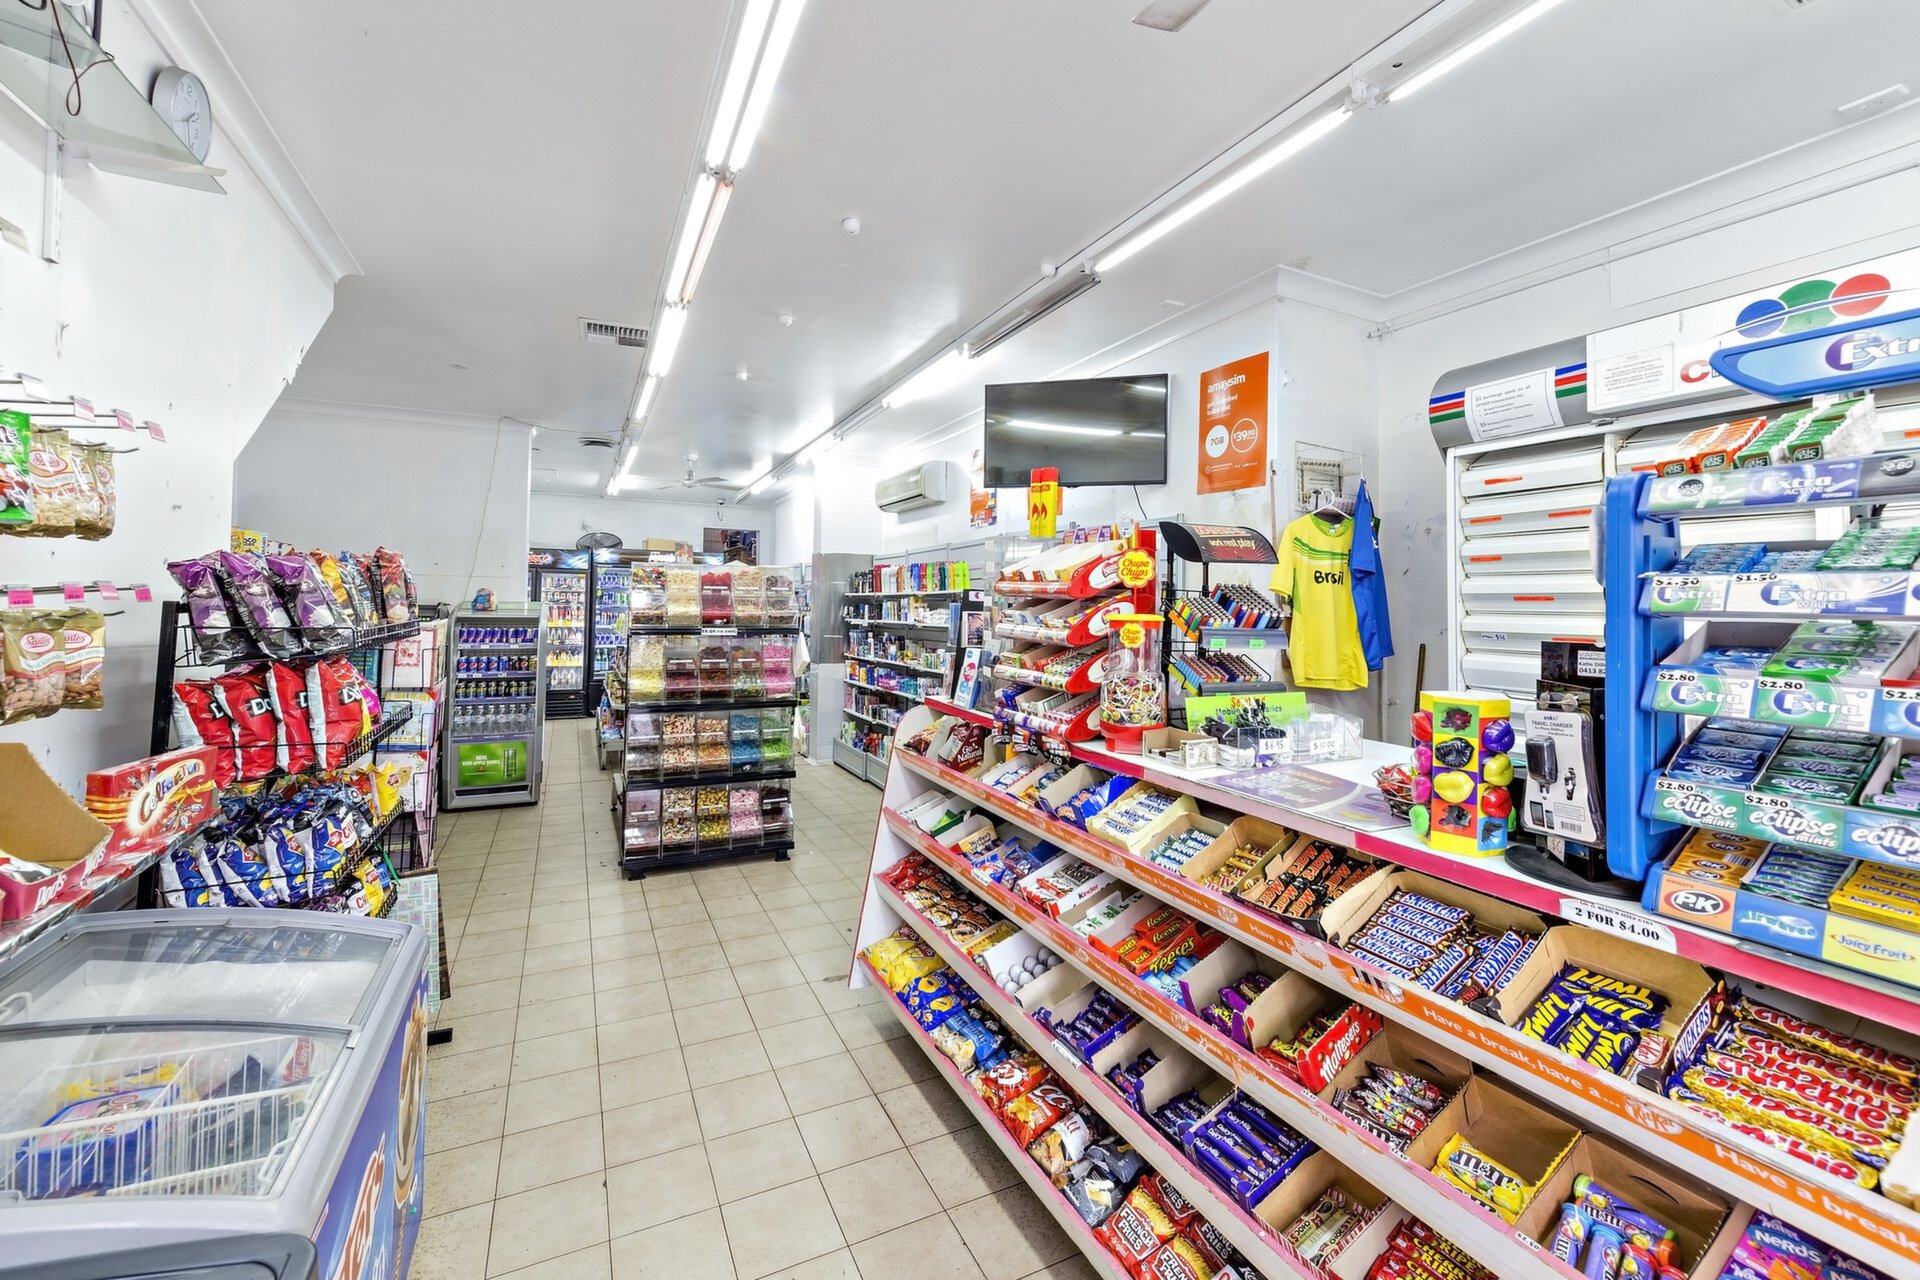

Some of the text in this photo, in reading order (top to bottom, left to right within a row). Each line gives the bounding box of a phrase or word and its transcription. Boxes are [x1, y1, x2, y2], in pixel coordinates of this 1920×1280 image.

[1208, 374, 1246, 393] amaysim
[1210, 436, 1224, 446] 7GB
[1761, 475, 1834, 492] Extra
[1121, 566, 1149, 578] Chups
[1122, 558, 1150, 571] Chupa
[1775, 586, 1848, 602] Extra
[1797, 601, 1836, 610] WHITE
[1658, 672, 1696, 682] $2.80
[1758, 680, 1804, 690] $2.80
[1678, 684, 1744, 704] Extra
[1783, 690, 1862, 716] Extra
[957, 748, 982, 762] Natural
[1657, 781, 1694, 792] $2.80
[1772, 778, 1839, 792] eclipse
[1663, 794, 1738, 820] eclipse
[1746, 795, 1789, 808] $2.80
[1702, 816, 1738, 830] mints
[1749, 808, 1838, 836] eclipse
[1795, 834, 1838, 848] mints
[1289, 844, 1318, 876] Mars
[1302, 848, 1334, 881] Mars
[1078, 884, 1100, 900] kinder
[1675, 893, 1718, 914] P.K
[1146, 908, 1172, 928] Reese's
[1389, 904, 1458, 932] SNICKERS
[1404, 892, 1470, 922] SNICKERS
[1153, 922, 1180, 944] Reese's
[1249, 923, 1276, 943] Have
[1379, 914, 1448, 944] SNICKERS
[1575, 907, 1660, 941] 2 FOR $4.00
[1739, 911, 1816, 939] Airwaves
[1358, 938, 1422, 968] SNICKERS
[1370, 927, 1434, 958] SNICKERS
[1838, 934, 1908, 962] Juicy Fruit
[1475, 932, 1522, 988] SNICKERS
[1566, 968, 1653, 1009] Twirl
[1520, 990, 1570, 1040] Twirl
[1319, 1020, 1362, 1084] Maltesers
[1424, 1006, 1463, 1034] Have
[1467, 1028, 1478, 1039] a
[1480, 1032, 1537, 1070] break,
[1538, 1058, 1582, 1090] have
[1752, 1007, 1917, 1072] Crunchie
[1747, 1036, 1920, 1101] Crunchie
[1716, 1056, 1889, 1130] Crunchie
[1704, 1076, 1884, 1148] Crunchie
[1714, 1144, 1790, 1189] Have
[1796, 1186, 1816, 1204] a
[1162, 1182, 1184, 1210] FRIES
[1118, 1218, 1142, 1250] FRIES
[1120, 1206, 1154, 1248] FRENCH
[1202, 1222, 1228, 1259] FRIES
[1297, 1220, 1311, 1236] CHOC
[1330, 1228, 1344, 1244] CHOC
[1440, 1242, 1476, 1272] RIPE
